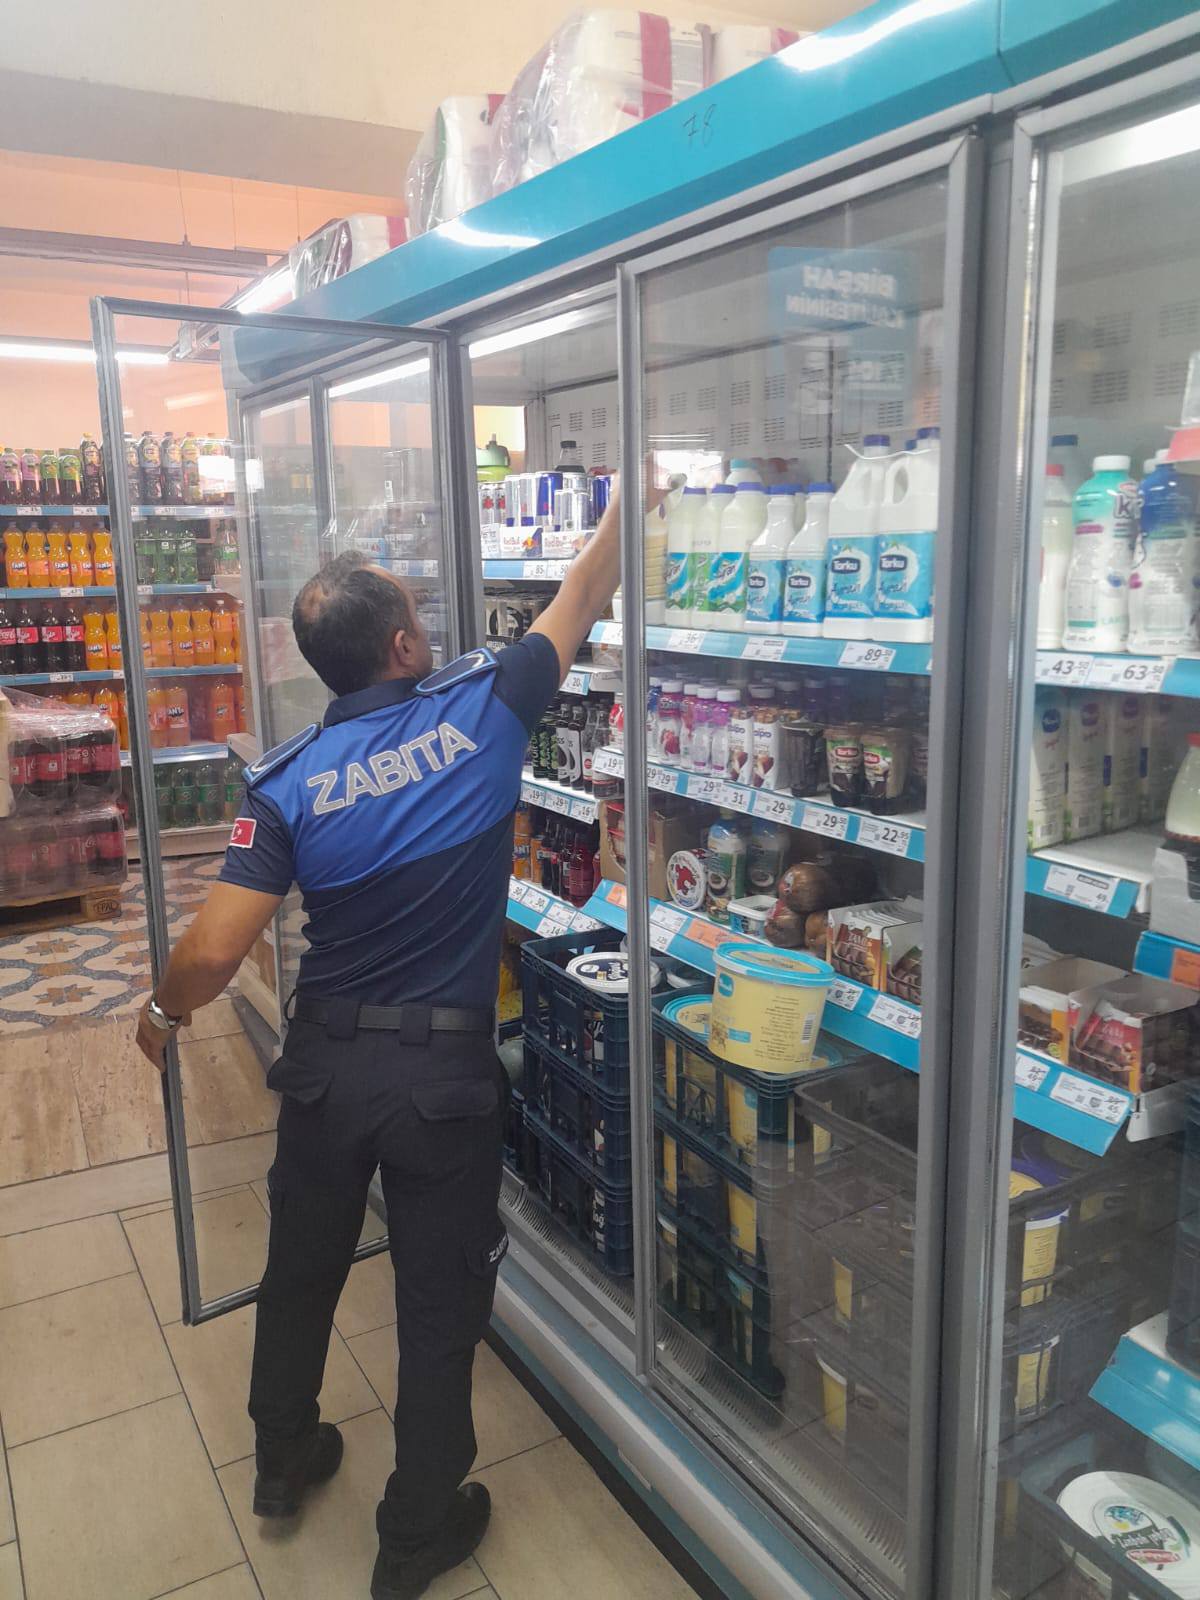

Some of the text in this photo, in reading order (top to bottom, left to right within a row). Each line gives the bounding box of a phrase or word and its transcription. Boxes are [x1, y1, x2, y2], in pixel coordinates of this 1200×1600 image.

[833, 560, 858, 571] Torku
[881, 557, 905, 569] Torku
[307, 722, 478, 816] ZABITA
